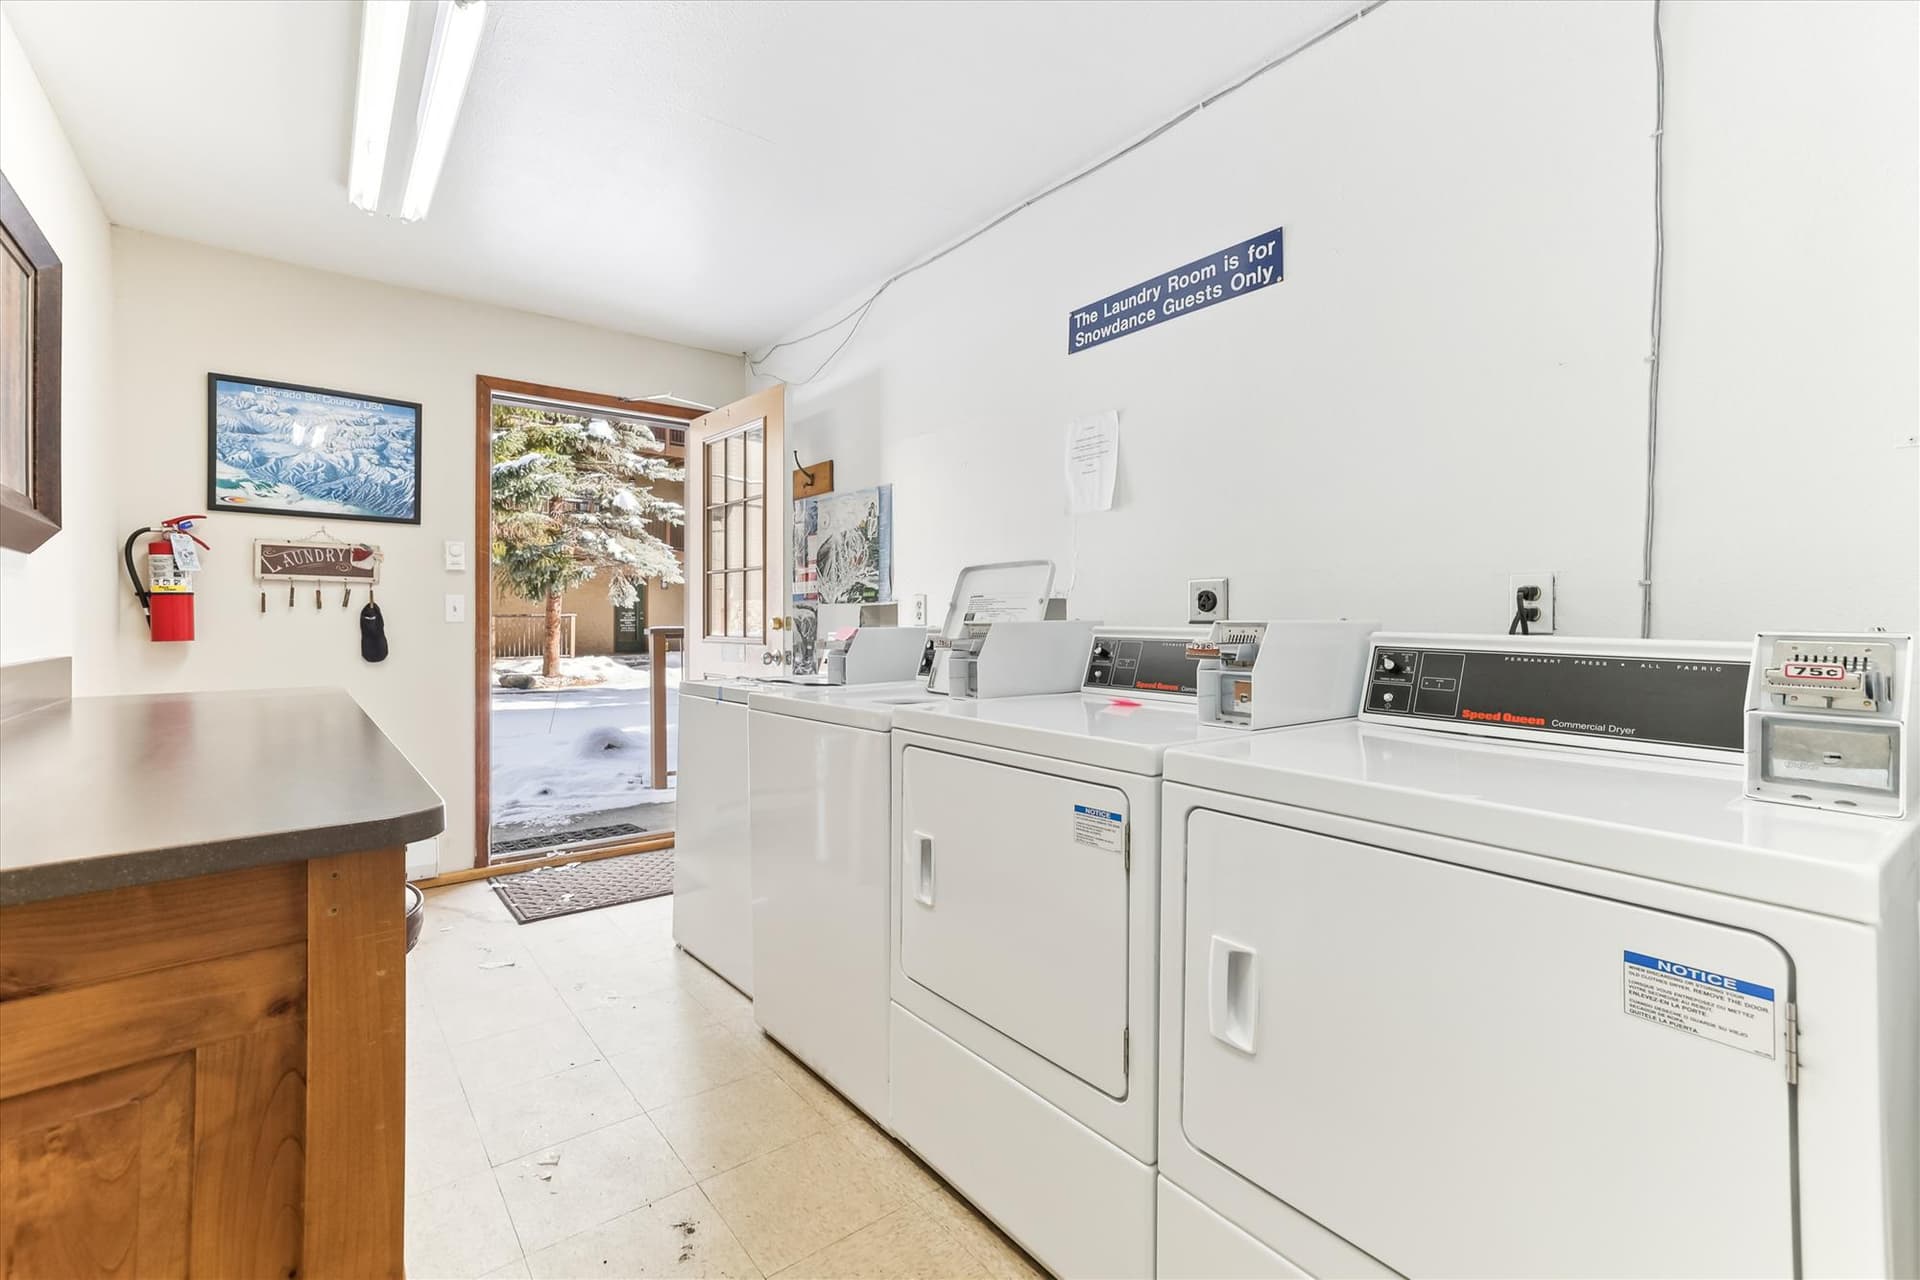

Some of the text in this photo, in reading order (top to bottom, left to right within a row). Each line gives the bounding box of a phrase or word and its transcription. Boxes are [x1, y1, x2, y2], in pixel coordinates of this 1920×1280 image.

[1074, 240, 1276, 329] The Laundry Room is for
[1075, 308, 1156, 347] Snowdance
[1162, 284, 1222, 316] Guests
[254, 385, 385, 411] Colorado Ski Country USA
[1504, 656, 1562, 664] PERMANENT
[1461, 709, 1636, 736] Speed Queen Commercial Dryer
[1085, 807, 1111, 820] NOTICE
[1657, 960, 1738, 990] NOTICE
[1693, 988, 1725, 1001] REMOVE
[1727, 997, 1743, 1006] THE
